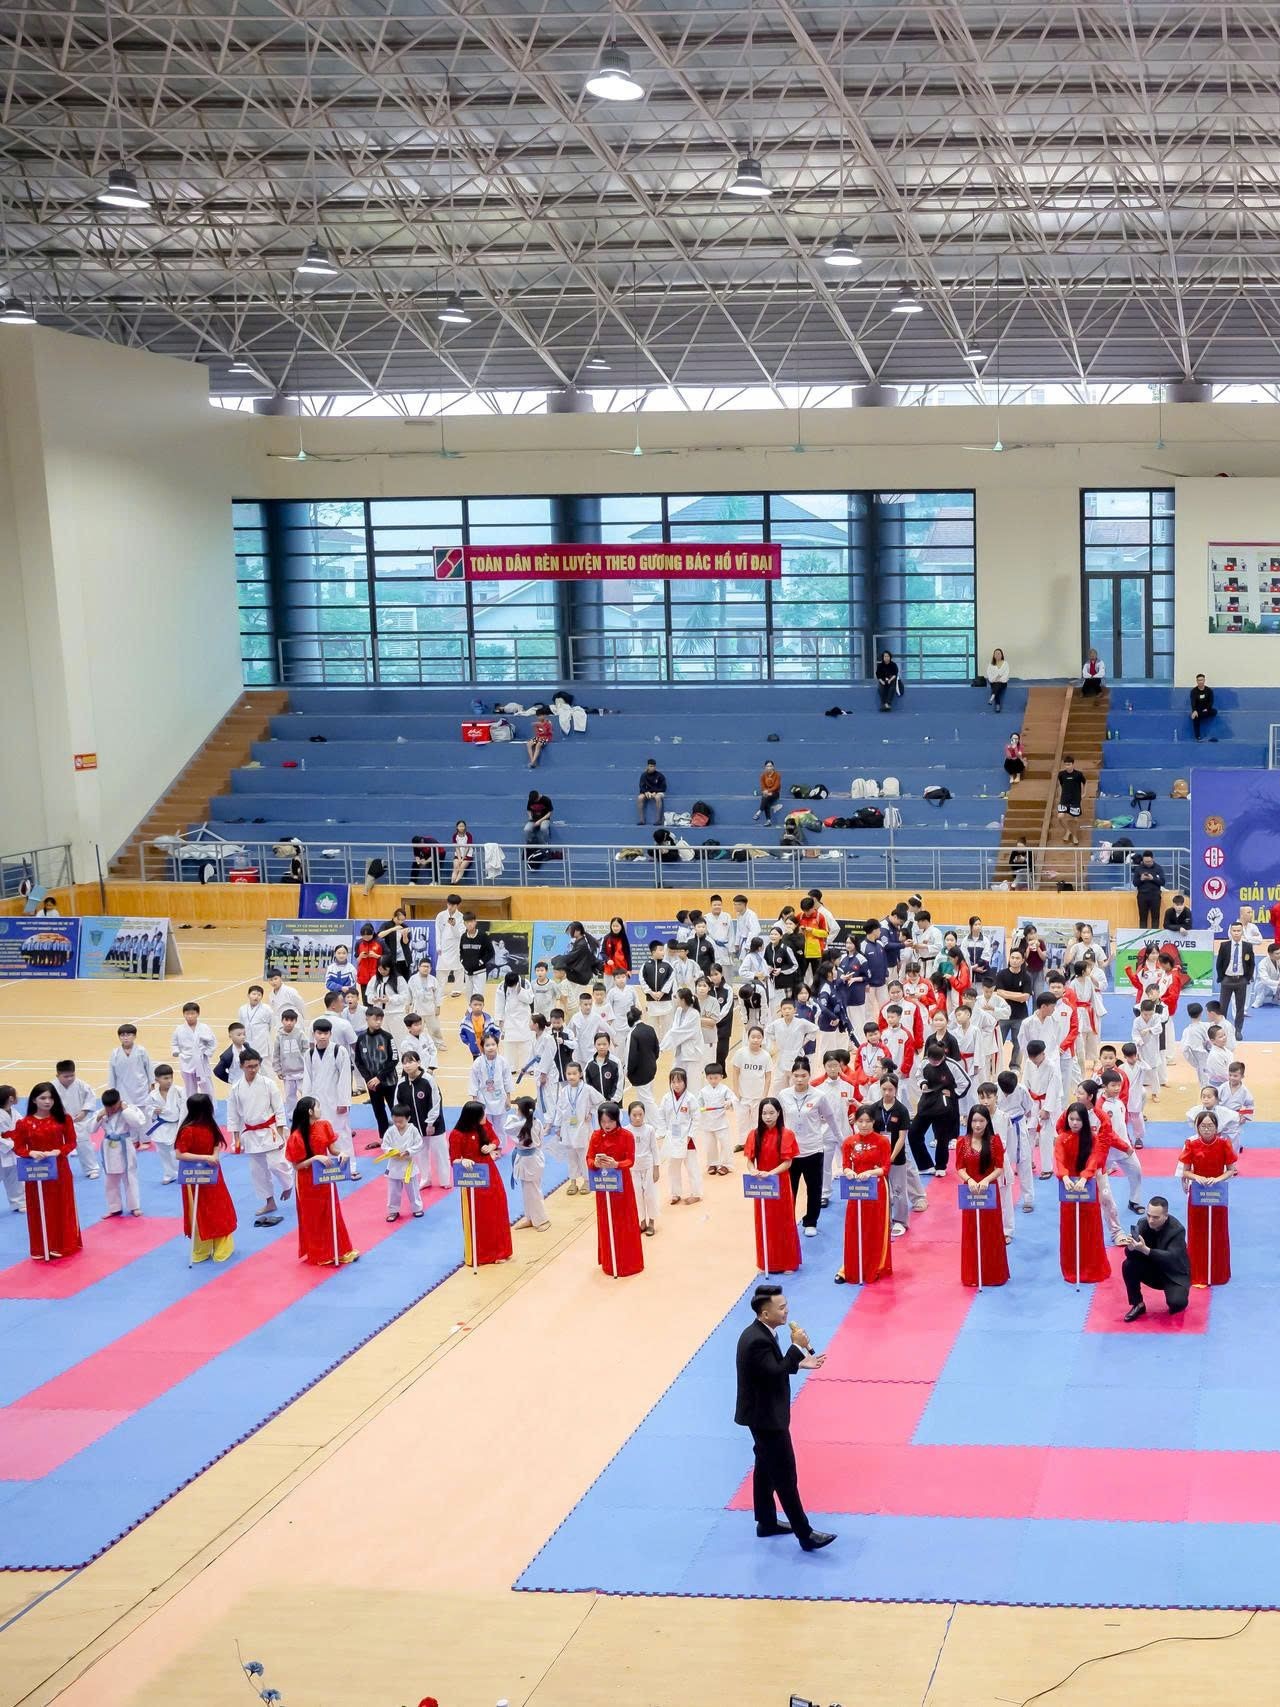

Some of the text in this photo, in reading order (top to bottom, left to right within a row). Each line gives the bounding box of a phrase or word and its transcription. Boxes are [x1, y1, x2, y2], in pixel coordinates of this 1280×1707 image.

[470, 554, 502, 572] TOÀN
[505, 553, 531, 572] DÂN
[534, 553, 559, 571] RÈN
[562, 552, 601, 574] LUYỆN
[605, 555, 636, 571] THEO
[640, 553, 682, 571] GƯƠNG
[685, 552, 711, 571] BÁC
[735, 552, 748, 571] VĨ
[751, 555, 772, 574] ĐẠI
[1240, 882, 1264, 901] GIẢI
[744, 1063, 763, 1071] DIOR
